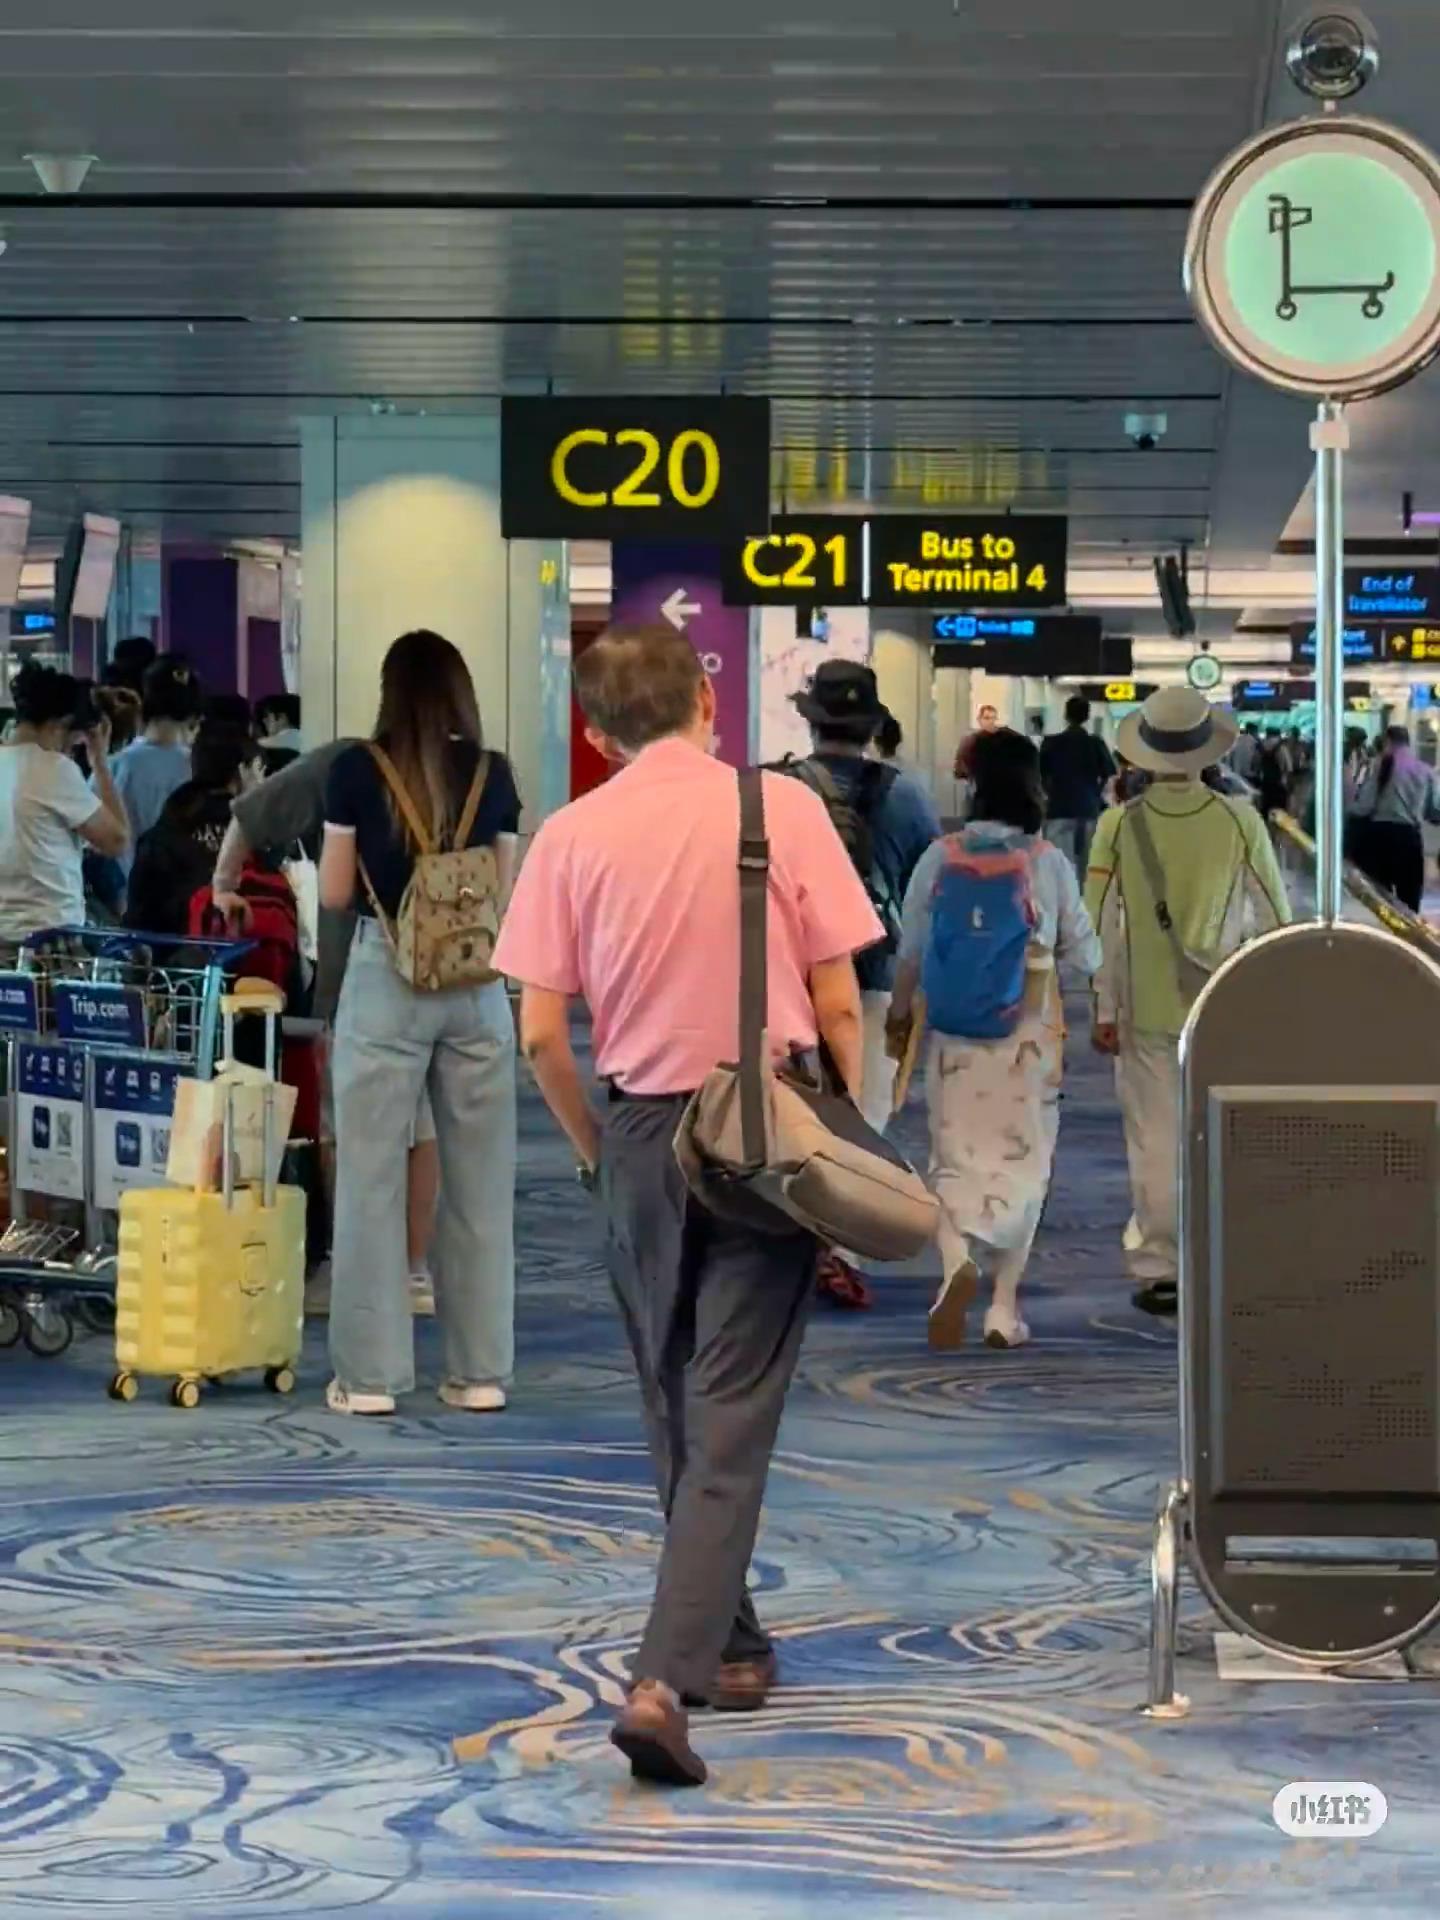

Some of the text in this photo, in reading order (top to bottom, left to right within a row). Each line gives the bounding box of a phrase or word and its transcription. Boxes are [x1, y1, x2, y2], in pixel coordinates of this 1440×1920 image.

[550, 427, 721, 509] C20
[740, 532, 847, 588] C21
[921, 530, 1016, 560] Bus to
[887, 561, 1048, 592] Terminal 4
[1361, 575, 1415, 593] End of
[69, 992, 131, 1022] Trip.com
